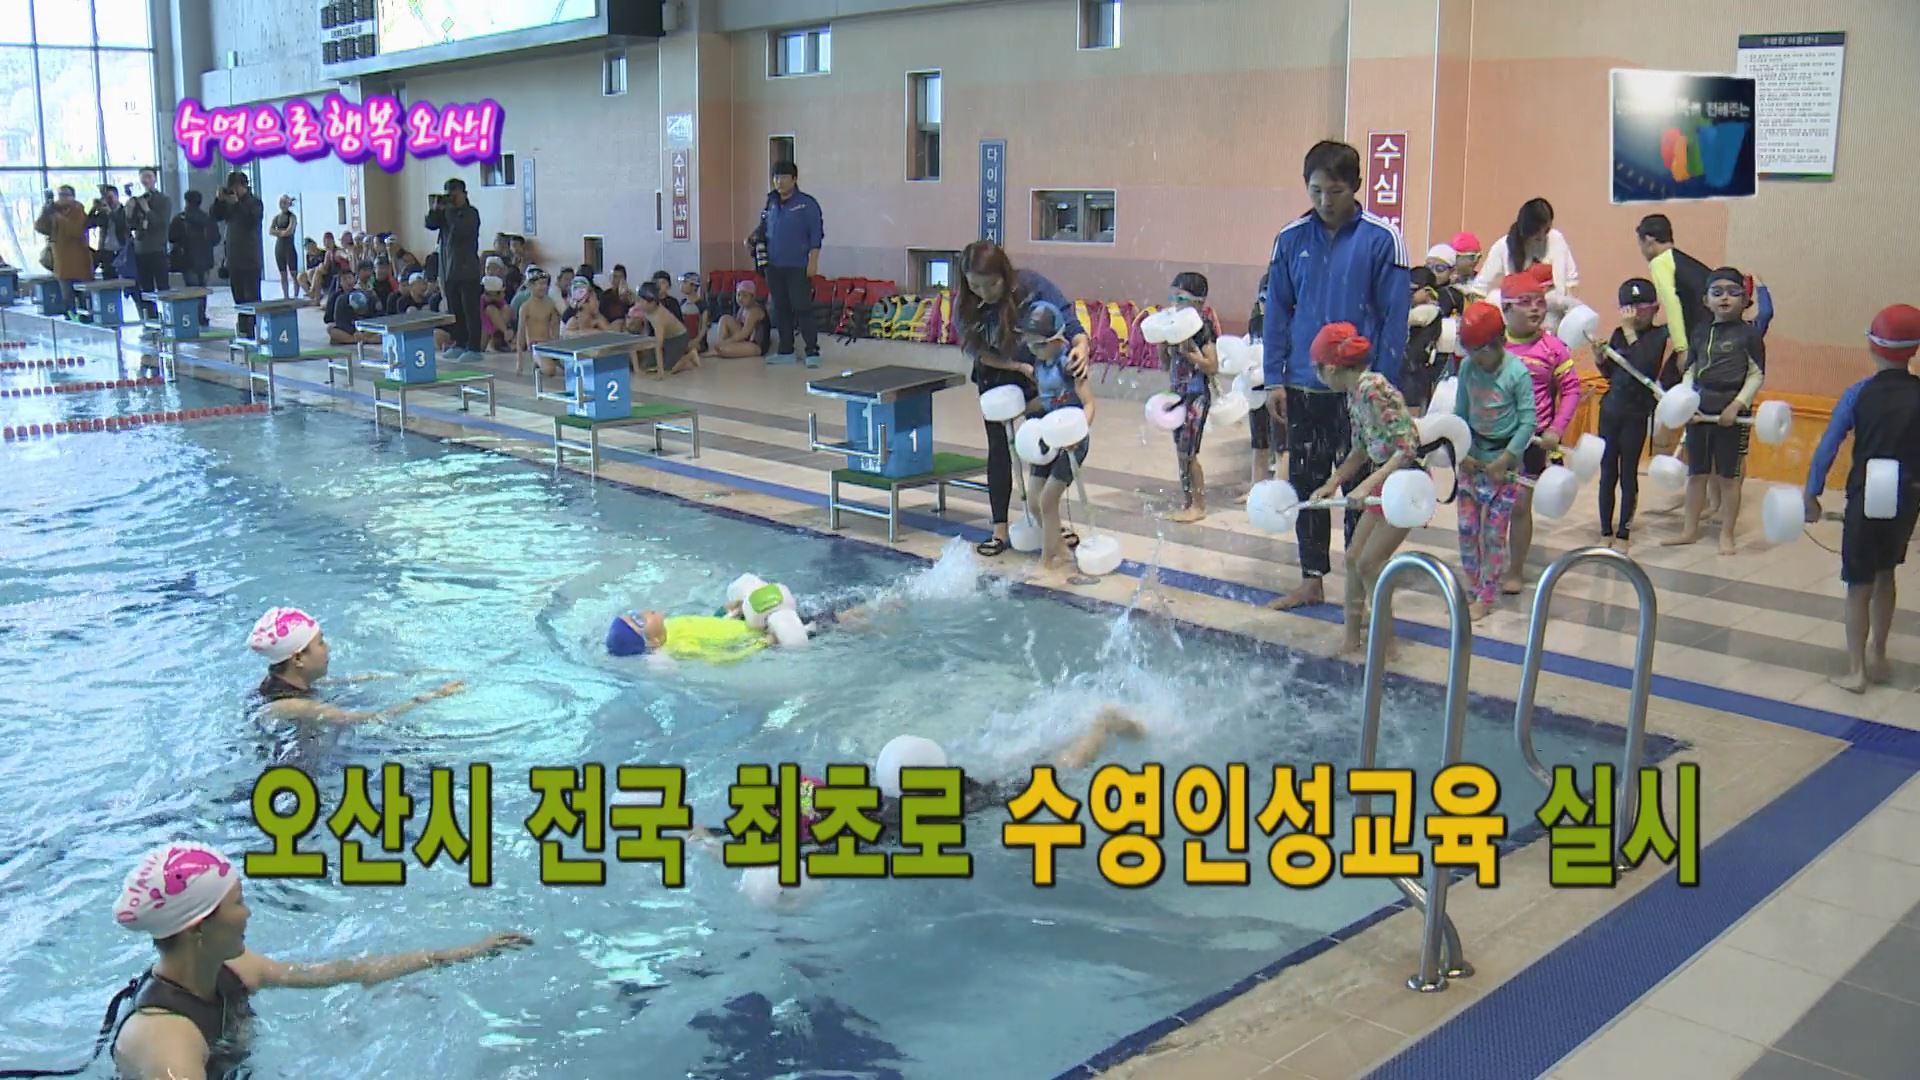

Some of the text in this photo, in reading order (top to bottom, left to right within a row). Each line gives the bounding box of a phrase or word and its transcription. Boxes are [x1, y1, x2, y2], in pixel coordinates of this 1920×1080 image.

[672, 153, 686, 197] 수심
[1374, 136, 1401, 204] 수심
[985, 146, 999, 246] 다이빙금지
[182, 315, 191, 327] 5
[279, 330, 289, 343] 4
[415, 350, 426, 368] 3
[607, 380, 620, 401] 2
[909, 428, 918, 453] 1
